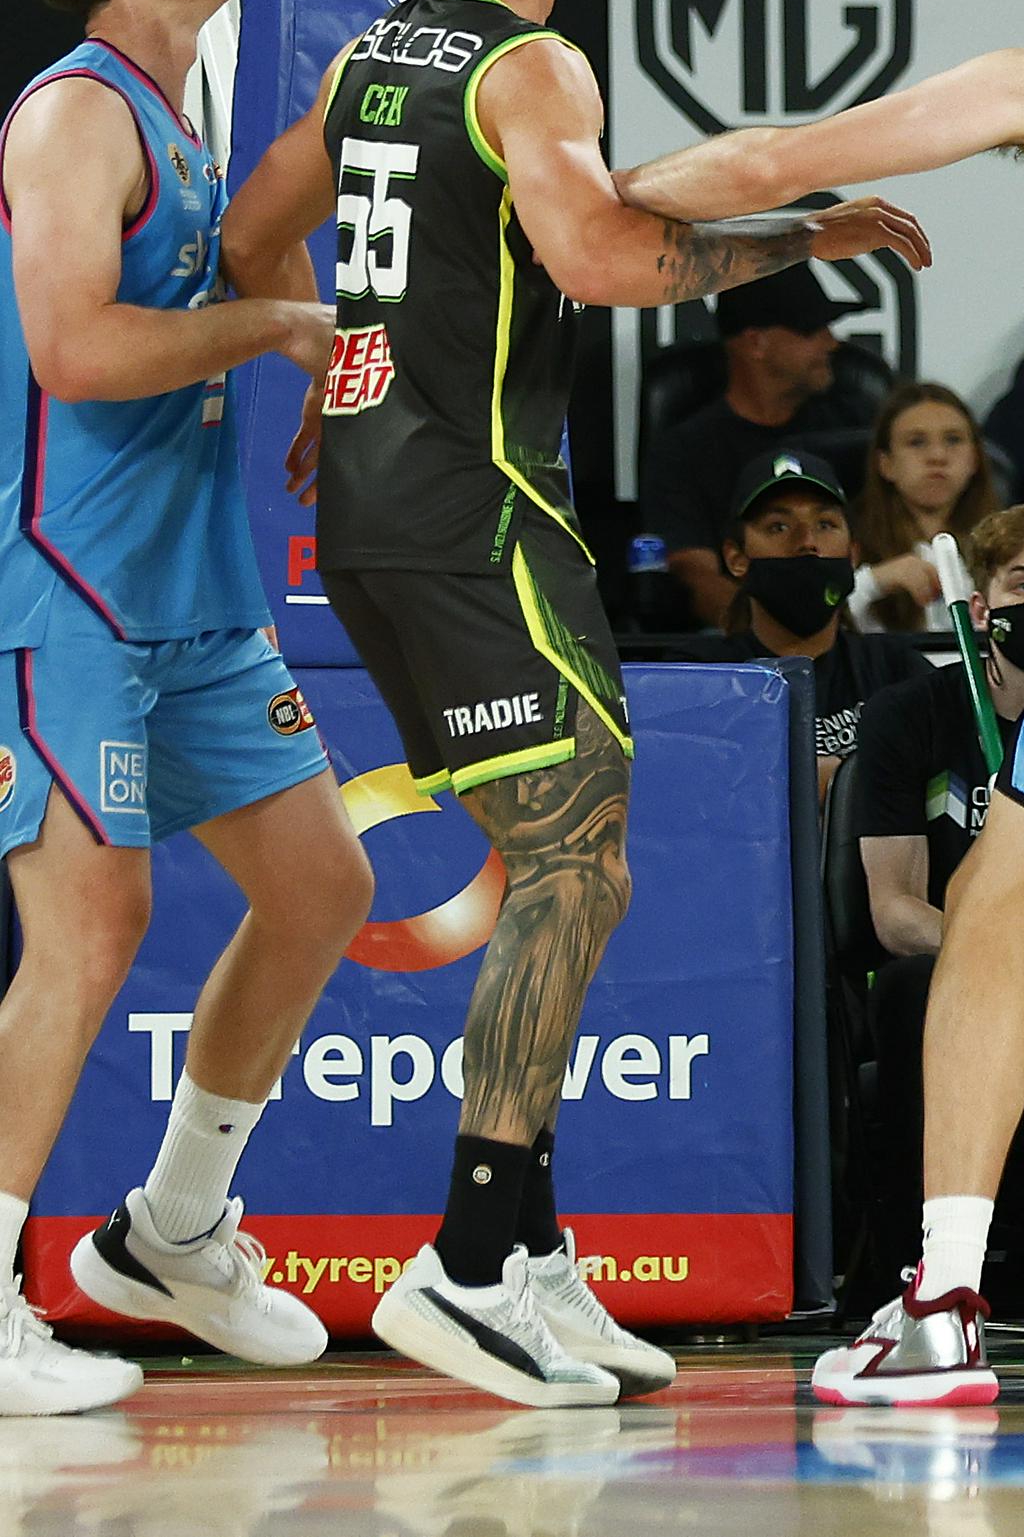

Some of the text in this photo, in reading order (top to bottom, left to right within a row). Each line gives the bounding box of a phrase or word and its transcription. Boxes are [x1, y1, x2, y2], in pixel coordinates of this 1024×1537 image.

[275, 706, 297, 727] NBL
[443, 691, 543, 737] TRADIE
[128, 1012, 709, 1127] Tepwer
